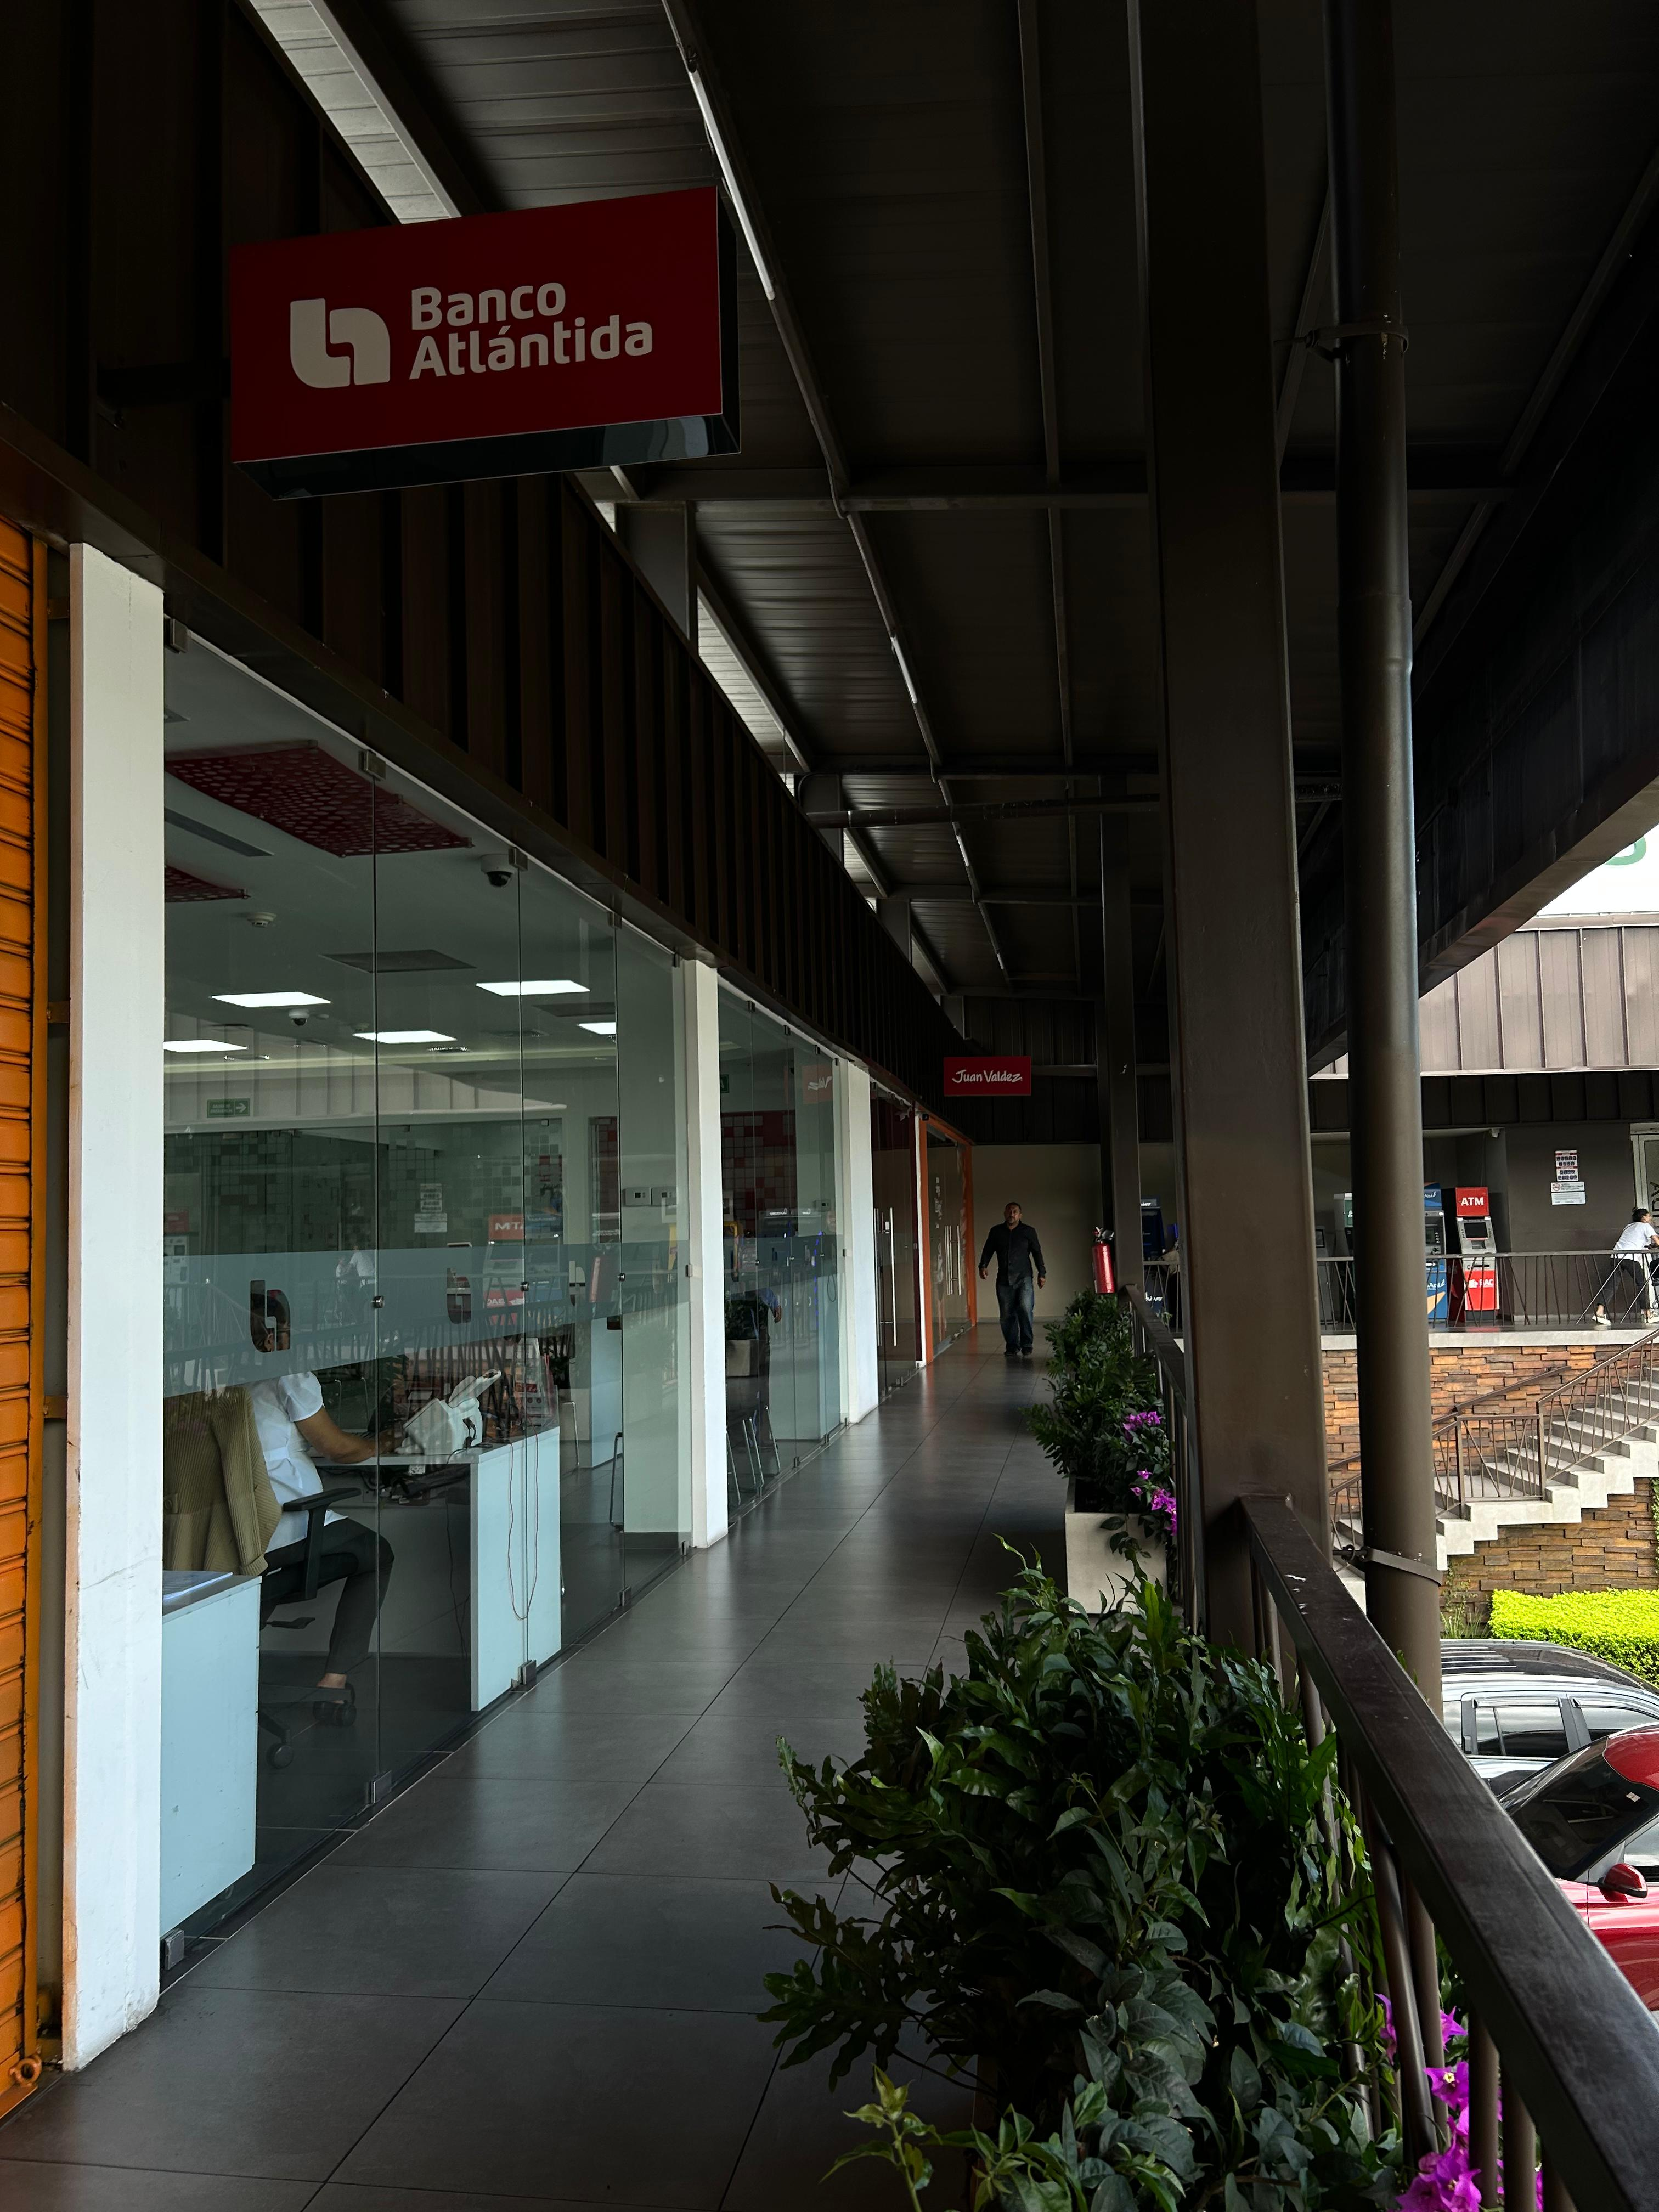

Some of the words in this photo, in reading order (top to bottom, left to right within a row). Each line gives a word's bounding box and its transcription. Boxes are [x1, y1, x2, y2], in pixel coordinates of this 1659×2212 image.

[410, 282, 566, 331] Banco
[409, 314, 653, 380] Atlántida
[952, 1069, 983, 1083] Juan
[983, 1070, 1023, 1083] Valdez
[1461, 1197, 1484, 1206] ATM
